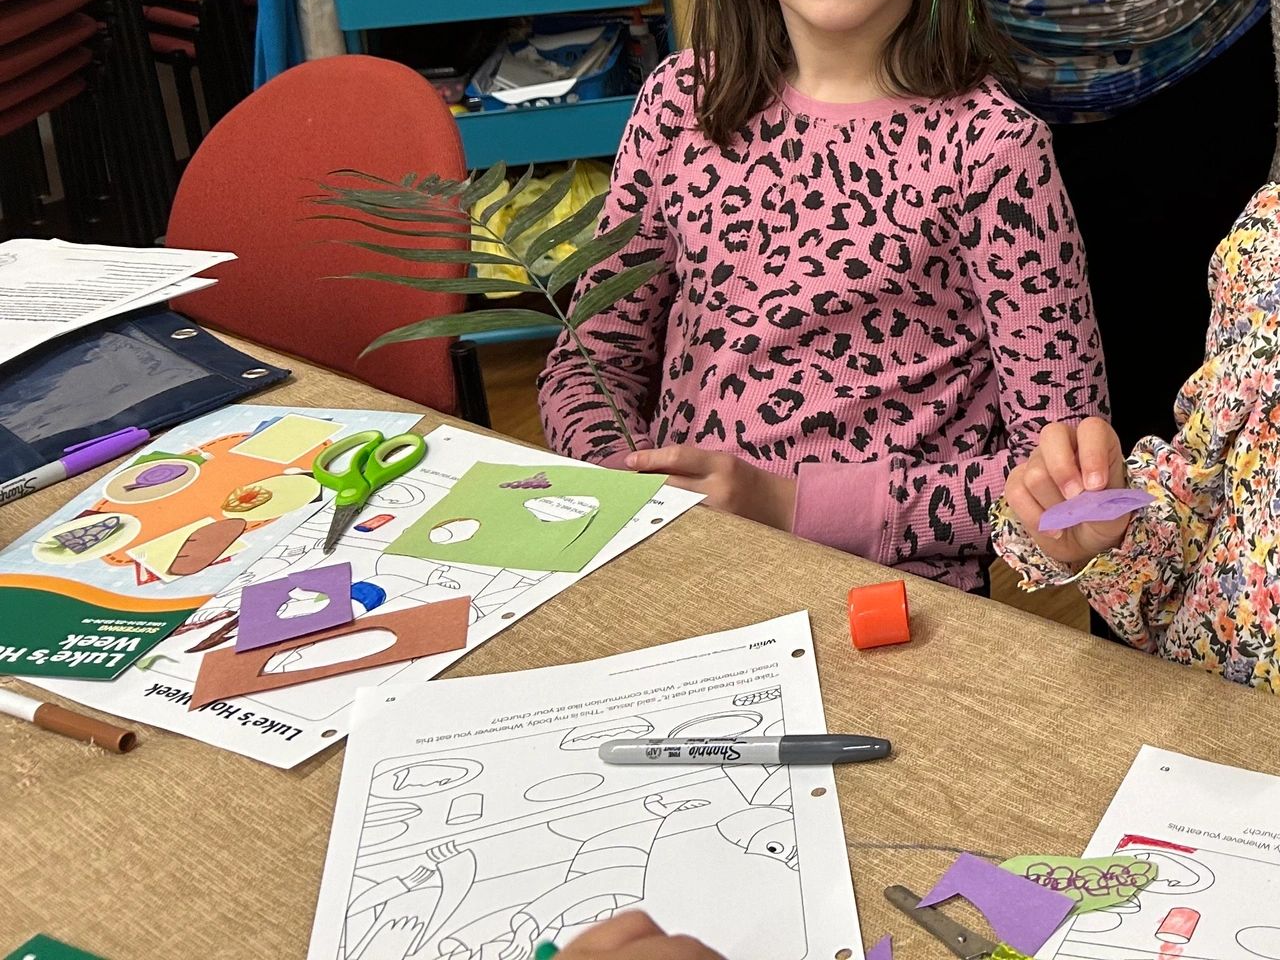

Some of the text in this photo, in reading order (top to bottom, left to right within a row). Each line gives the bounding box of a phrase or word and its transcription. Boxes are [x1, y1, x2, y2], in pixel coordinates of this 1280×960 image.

[0, 477, 37, 502] Sharp
[96, 624, 160, 634] SUFFERING
[59, 634, 141, 652] Week
[0, 646, 126, 668] Luke's Ho
[750, 662, 778, 672] bread,
[700, 669, 748, 684] remember
[708, 682, 734, 691] bread
[736, 678, 752, 686] this
[643, 684, 675, 696] What's
[672, 690, 686, 699] eat
[688, 686, 706, 696] and
[584, 691, 642, 706] communion
[636, 698, 656, 706] said
[144, 683, 303, 741] Luke's Hol Week
[533, 707, 554, 716] your
[556, 706, 566, 714] at
[567, 703, 582, 711] like
[606, 702, 635, 712] Jesus.
[491, 712, 531, 724] church?
[554, 714, 568, 722] my
[570, 712, 578, 720] is
[526, 717, 552, 727] body.
[454, 730, 472, 738] you
[474, 722, 523, 736] Whenever
[416, 736, 434, 744] this
[436, 734, 452, 742] eat
[1168, 822, 1185, 832] this
[1186, 827, 1202, 837] eat
[1204, 830, 1220, 840] you
[1222, 835, 1270, 851] Whenever
